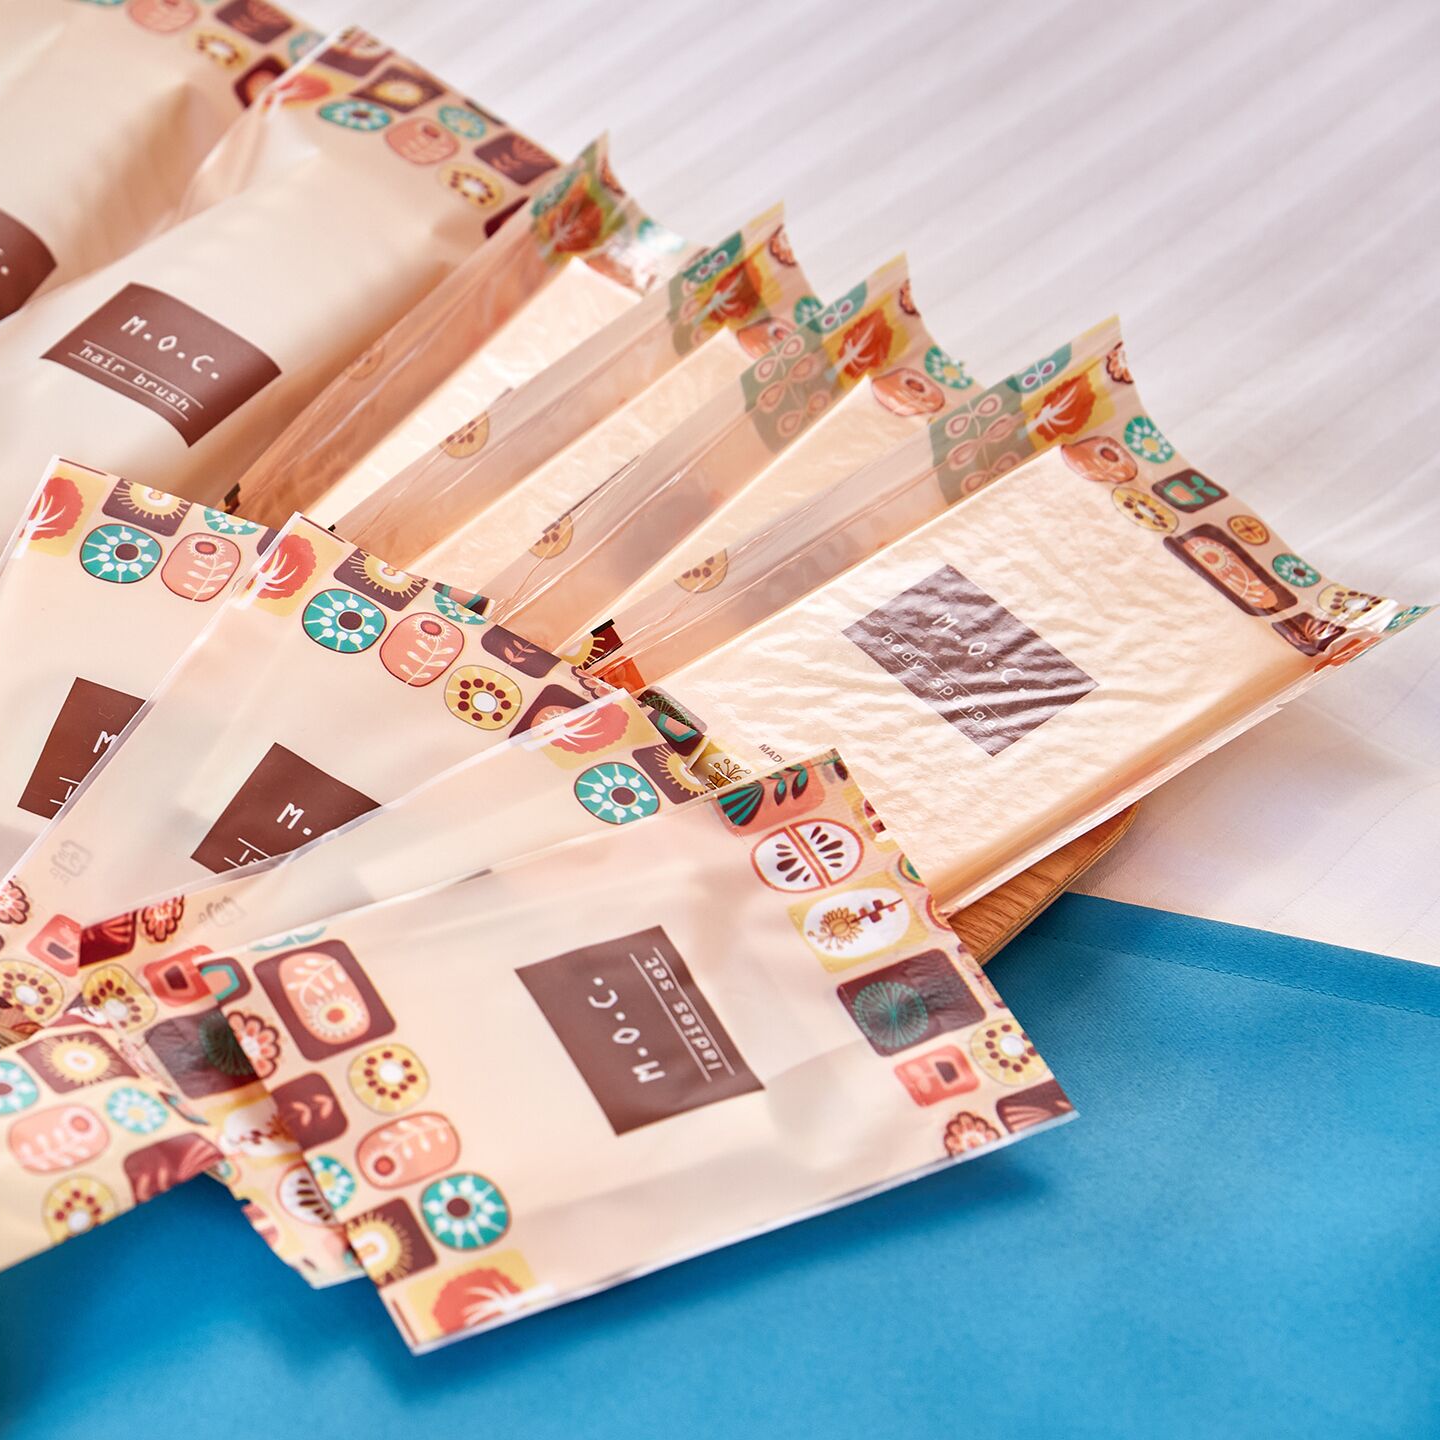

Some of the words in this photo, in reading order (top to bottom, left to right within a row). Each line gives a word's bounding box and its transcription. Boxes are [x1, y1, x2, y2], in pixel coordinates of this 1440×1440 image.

[79, 345, 125, 374] hair
[132, 369, 191, 412] brush
[120, 315, 220, 380] M.O.C.
[881, 632, 925, 670] body
[932, 612, 1027, 693] M.O.C.
[758, 743, 786, 764] MAD
[644, 957, 675, 992] set
[587, 976, 666, 1084] M.O.C.
[673, 1001, 723, 1071] ladies
